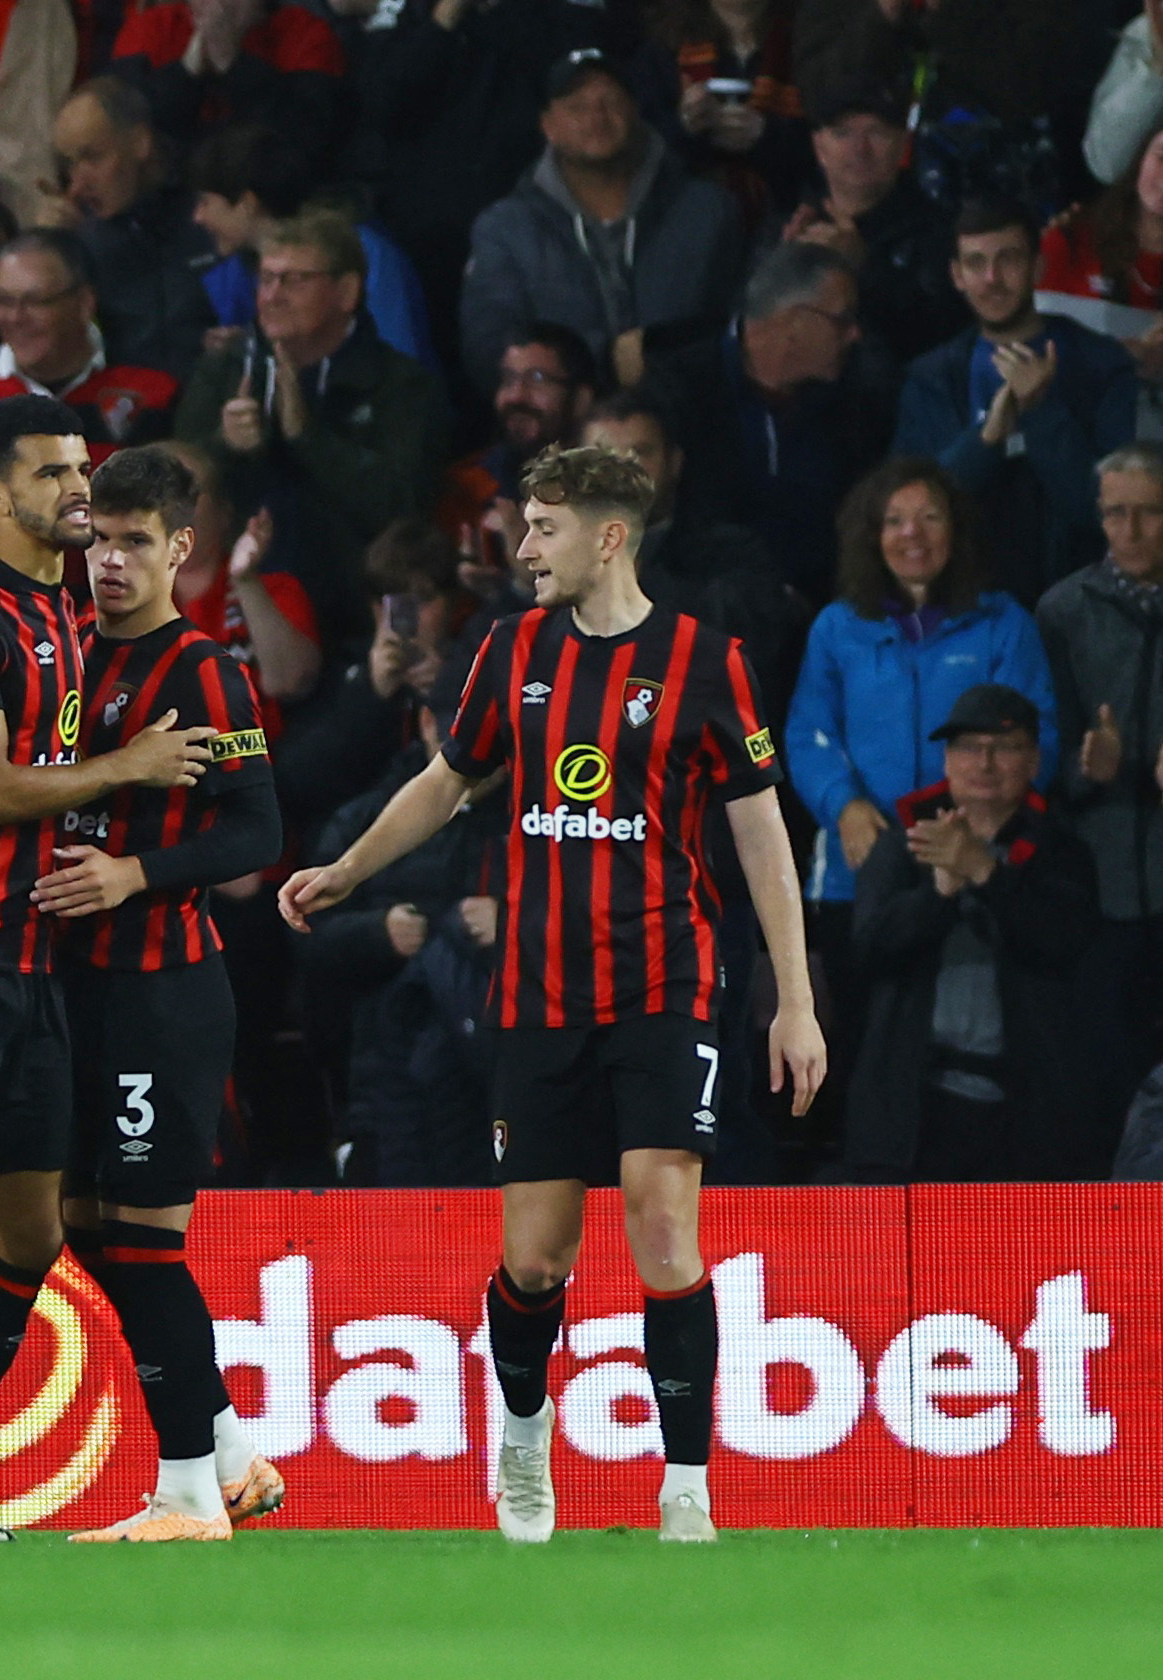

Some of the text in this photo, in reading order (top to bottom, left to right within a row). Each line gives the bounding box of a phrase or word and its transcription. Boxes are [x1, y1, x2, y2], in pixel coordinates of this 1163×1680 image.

[521, 803, 647, 843] dafabet
[116, 1073, 155, 1137] 3
[696, 1043, 719, 1107] 7
